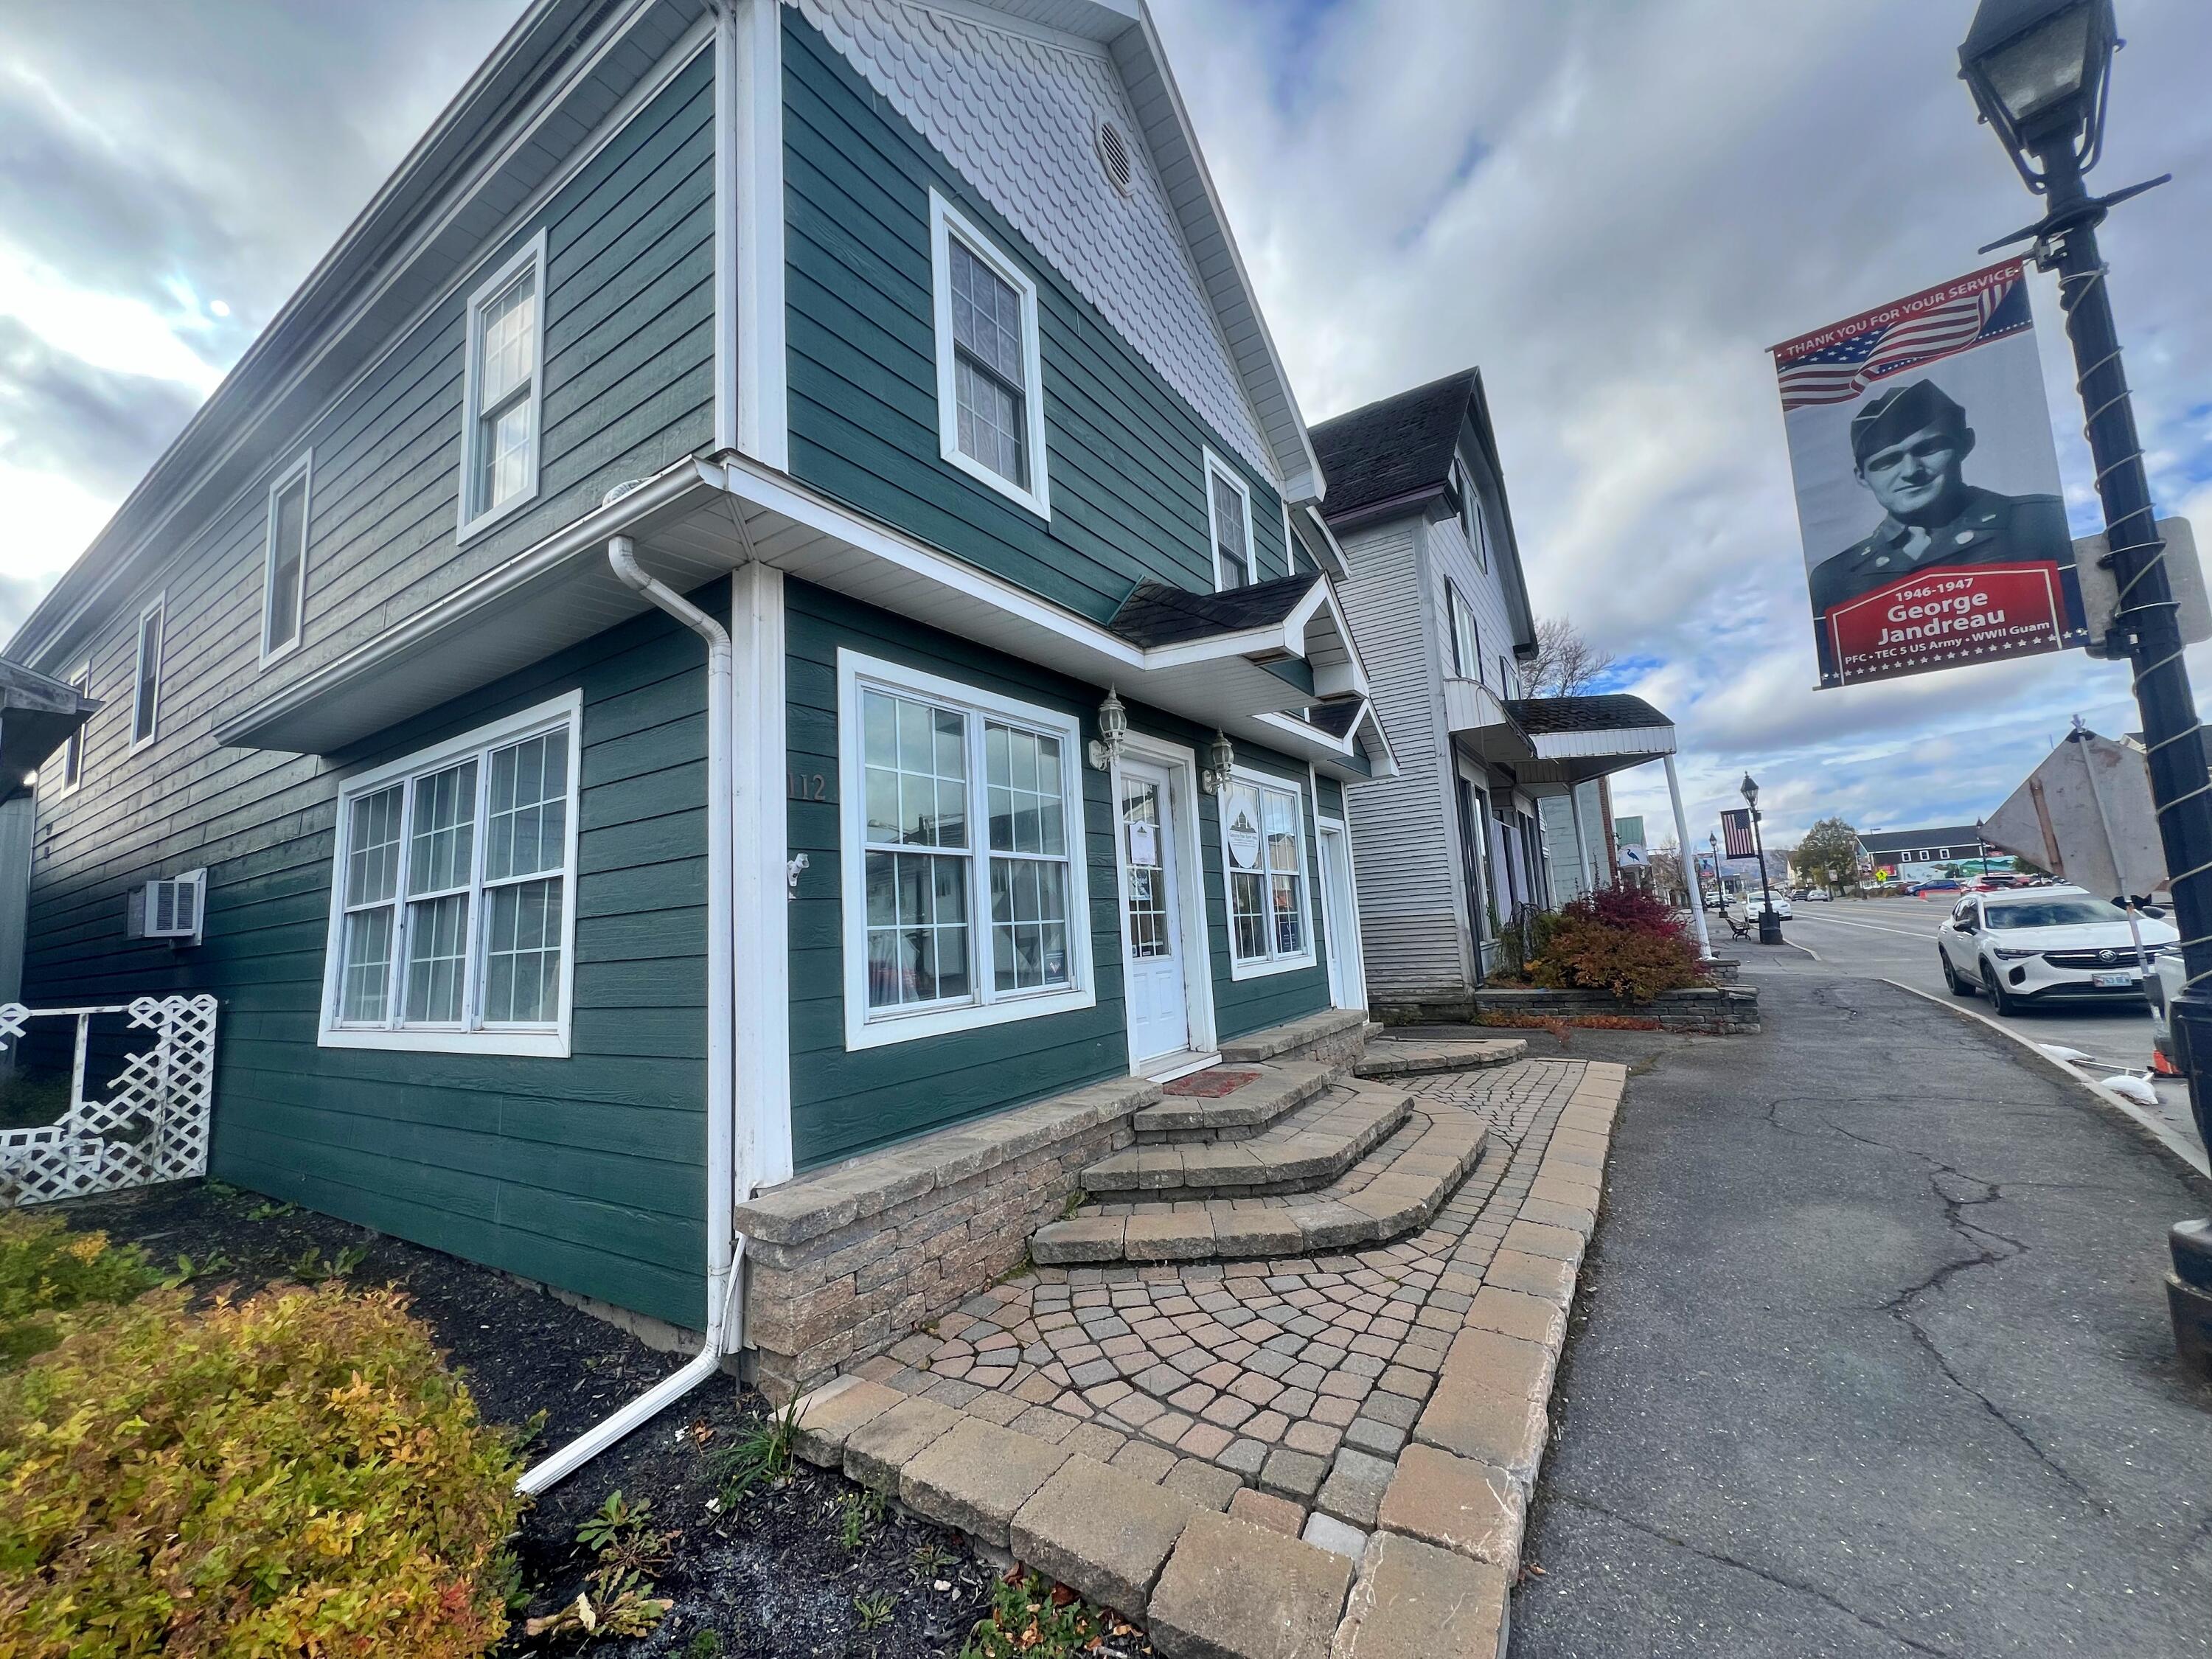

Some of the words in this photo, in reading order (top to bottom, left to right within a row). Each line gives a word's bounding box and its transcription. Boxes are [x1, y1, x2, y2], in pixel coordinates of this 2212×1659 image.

[1787, 331, 1834, 356] THANK
[1837, 320, 1867, 338] YOU
[1870, 308, 1900, 327] FOR
[1902, 292, 1945, 314] YOUR
[1948, 266, 2014, 299] SERVICE
[1888, 592, 1989, 622] George
[1895, 577, 1974, 602] 1946-1947
[1845, 653, 1867, 664] PFC
[1874, 648, 1898, 659] TEC
[1899, 646, 1907, 655] 5
[1910, 642, 1927, 653] US
[1929, 637, 1963, 650] Army
[1971, 627, 2007, 642] WWII
[2009, 622, 2050, 635] Guam
[1877, 609, 2006, 646] Jandreau
